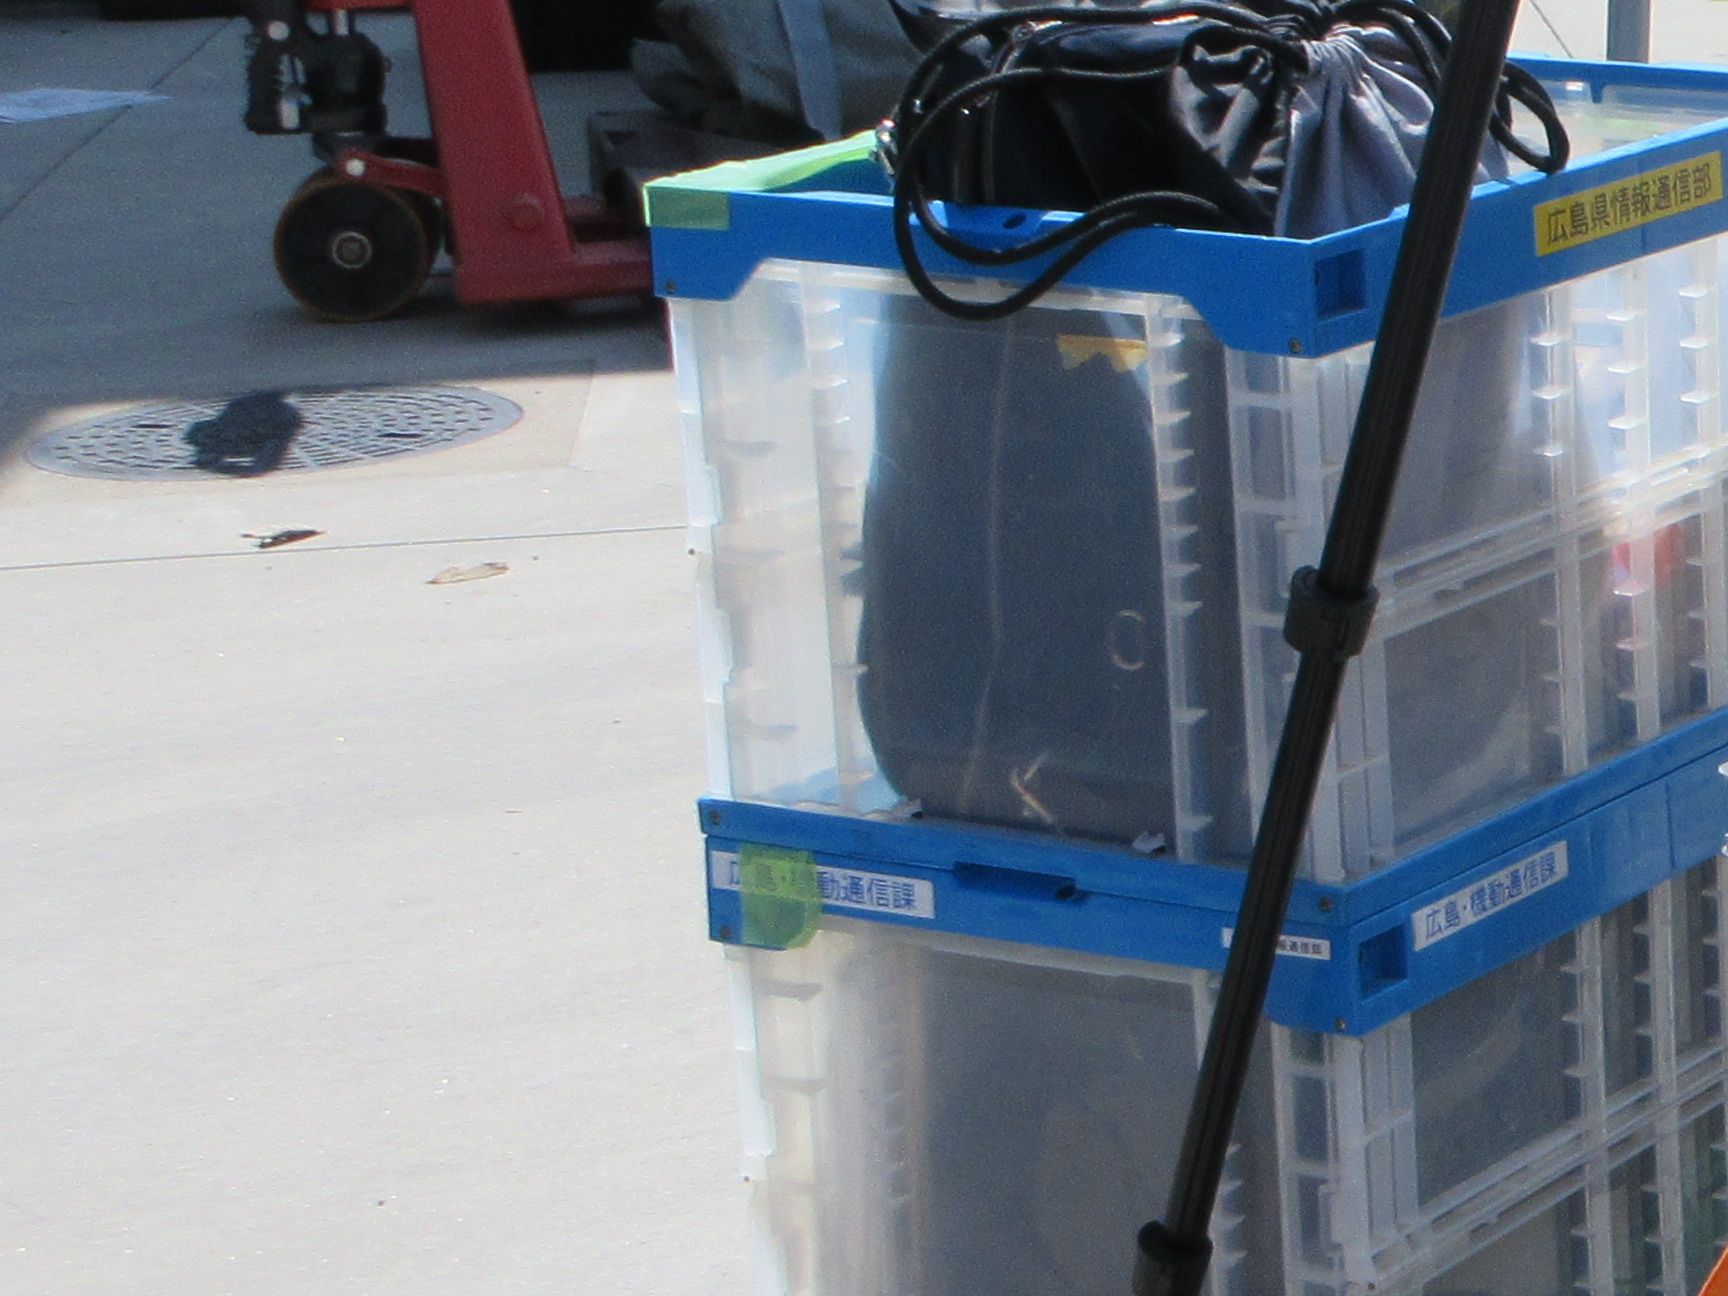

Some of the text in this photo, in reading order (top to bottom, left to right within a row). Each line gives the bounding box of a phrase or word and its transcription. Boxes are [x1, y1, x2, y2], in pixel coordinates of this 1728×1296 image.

[1547, 162, 1712, 244] 広島県情報通信部
